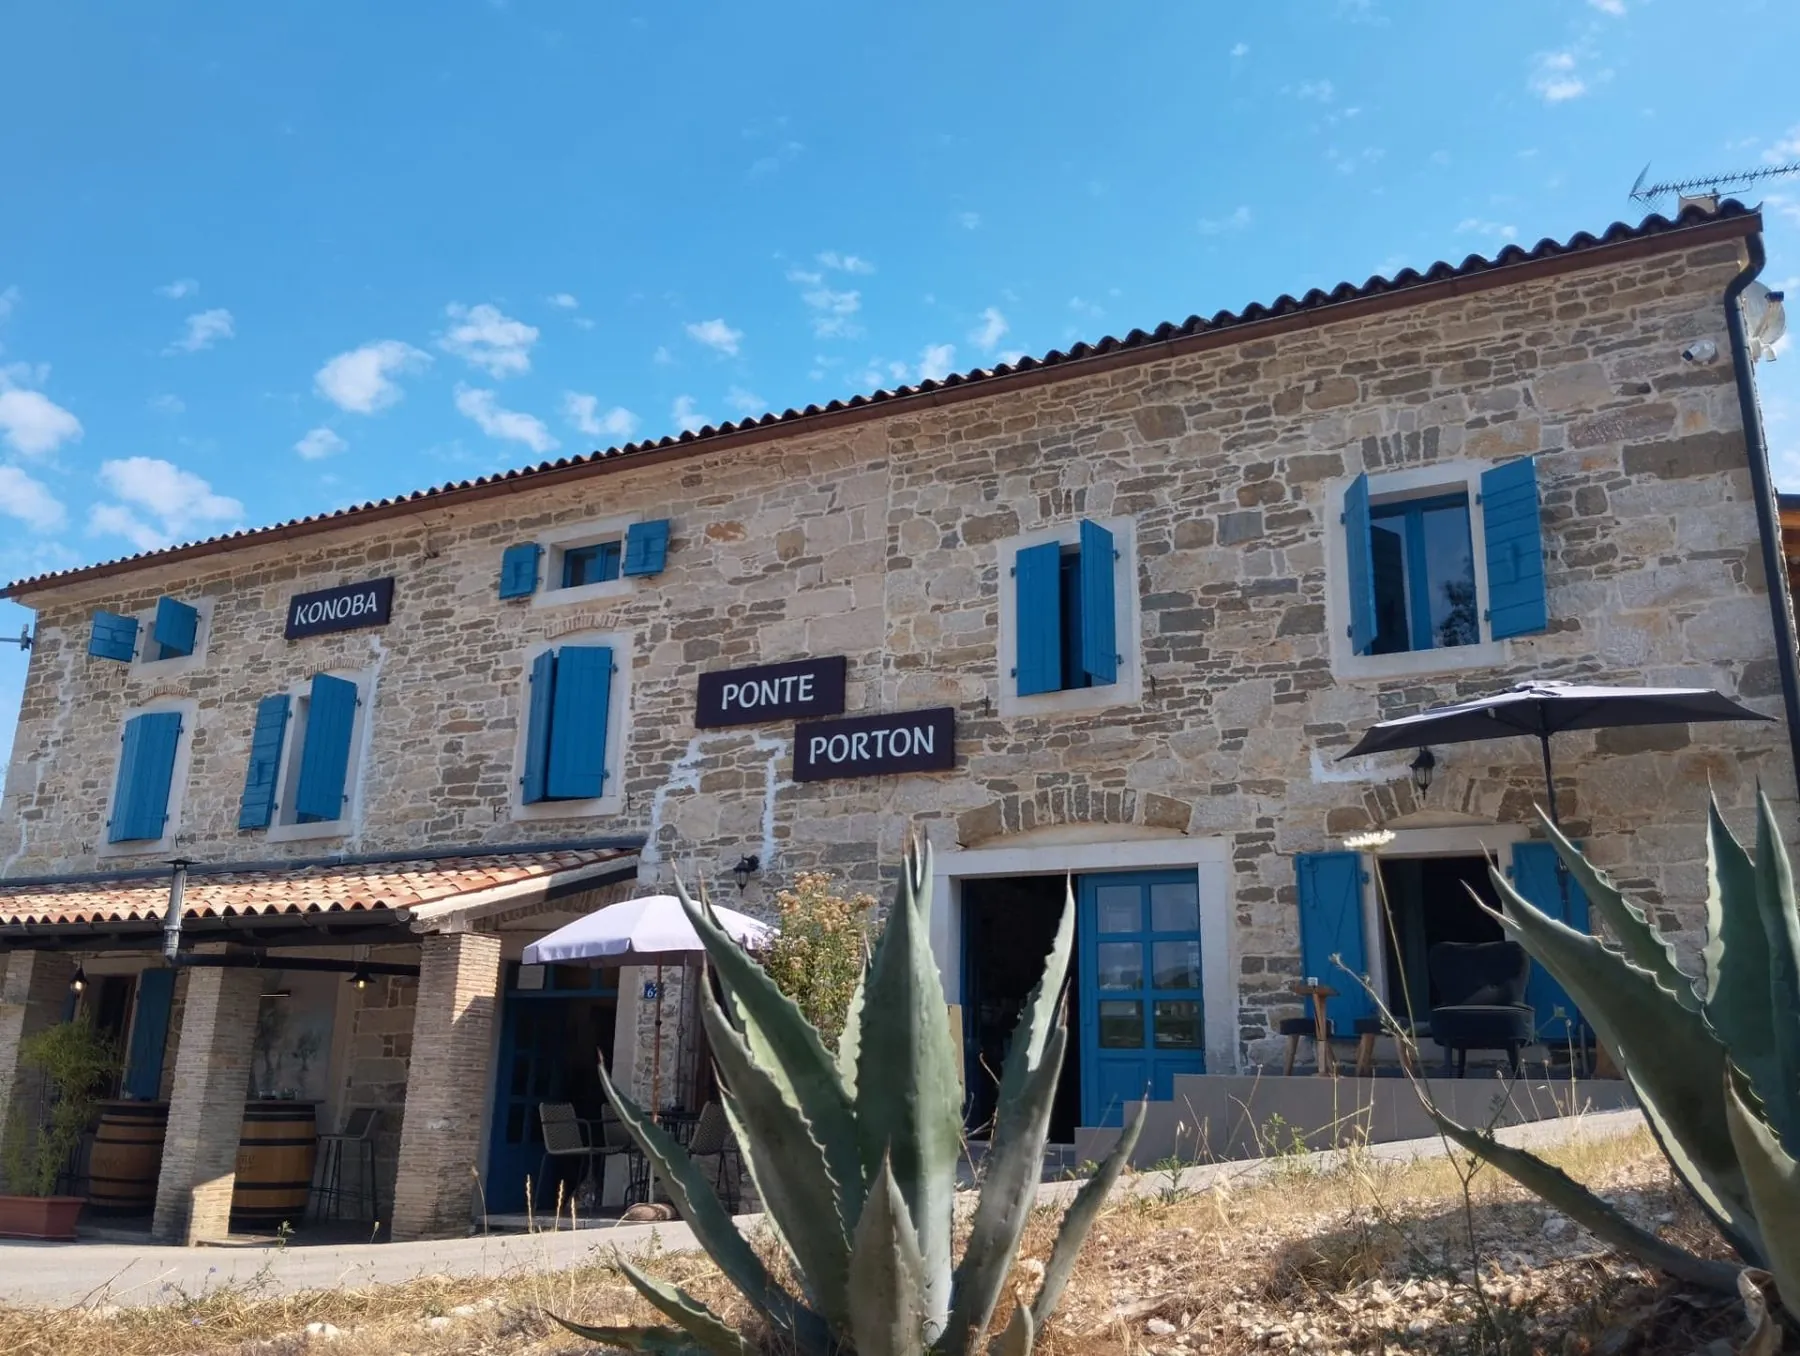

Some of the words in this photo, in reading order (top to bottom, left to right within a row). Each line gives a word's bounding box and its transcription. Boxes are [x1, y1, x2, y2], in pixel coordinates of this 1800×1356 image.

[294, 591, 377, 626] KONOBA
[721, 673, 815, 710] PONTE
[809, 725, 934, 764] PORTON
